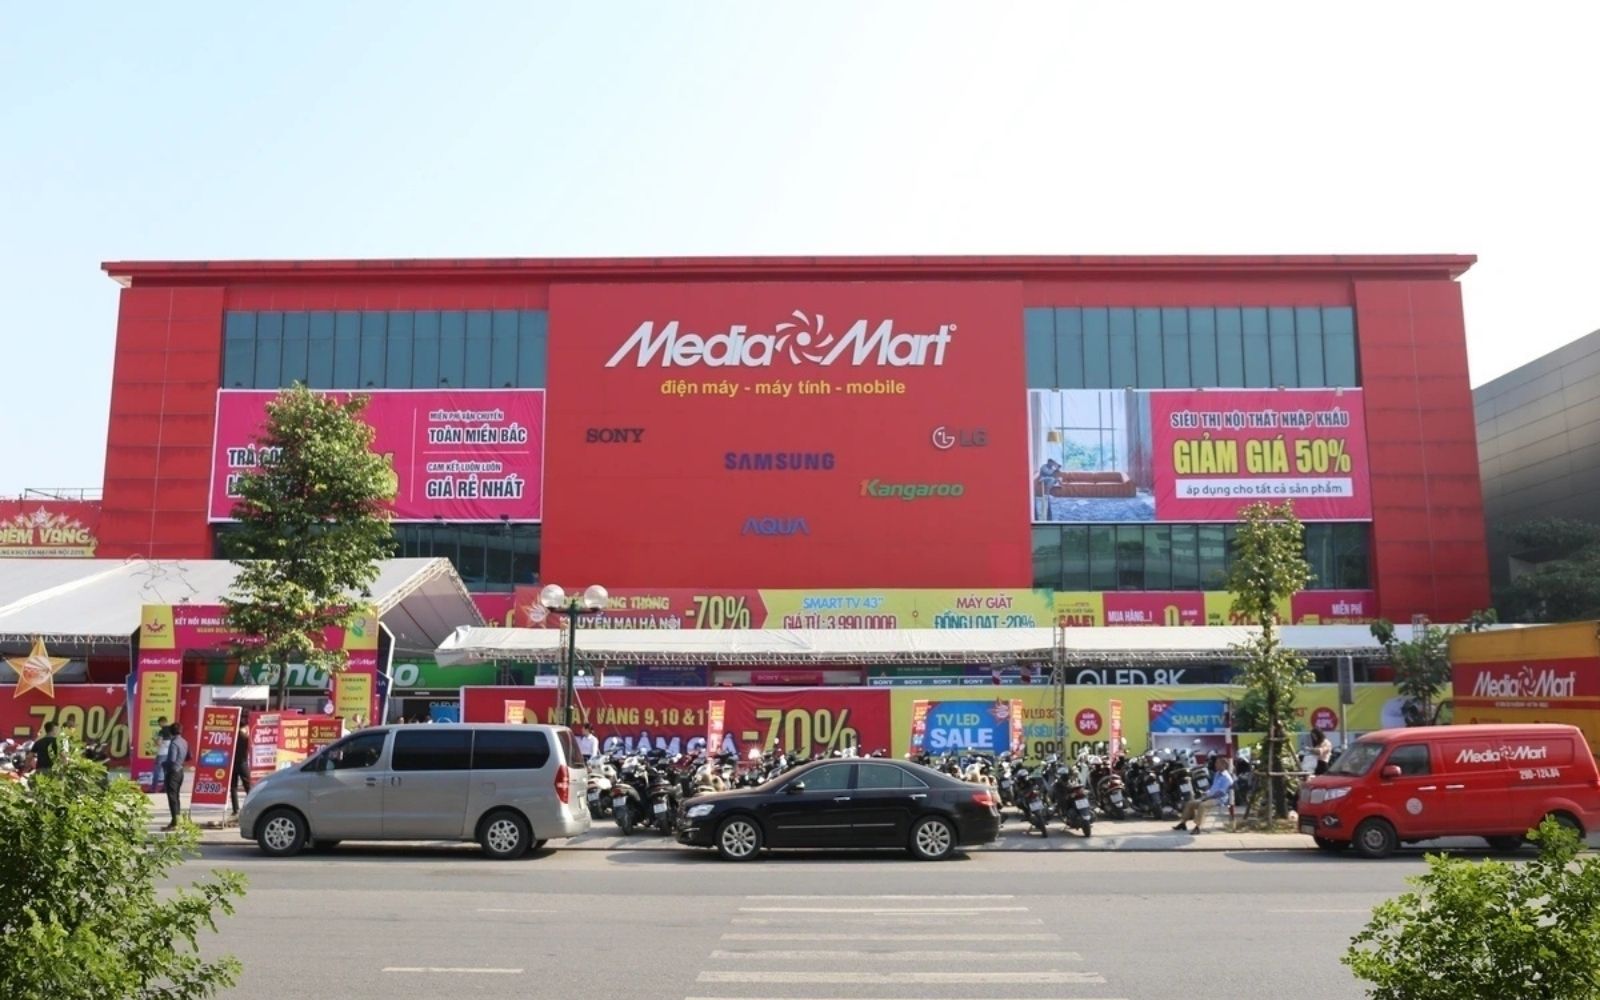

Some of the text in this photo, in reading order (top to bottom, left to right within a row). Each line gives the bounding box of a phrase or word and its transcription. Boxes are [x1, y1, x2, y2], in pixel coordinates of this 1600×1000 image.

[604, 320, 953, 367] Media Mart
[661, 380, 698, 397] điện
[702, 380, 739, 397] máy
[755, 380, 793, 397] máy
[798, 380, 831, 396] tính
[846, 380, 906, 395] mobile
[1171, 407, 1349, 430] SIÊU THỊ NỘI THẤT NHẬP KHẨU
[429, 424, 461, 443] TOÀN
[501, 422, 526, 443] BẮC
[586, 428, 645, 443] SONY
[959, 429, 989, 447] LG
[724, 452, 835, 470] SAMSUNG
[1173, 432, 1351, 474] GIẢM GIÁ 50%
[428, 462, 445, 472] CAM
[446, 459, 460, 472] KẾT
[427, 476, 454, 498] GIÁ
[458, 473, 477, 498] RẺ
[482, 473, 523, 498] NHẤT
[860, 479, 965, 500] Kangaroo
[1186, 479, 1342, 497] áp dụng cho tất cả sản phẩm
[741, 516, 809, 536] AQUA
[631, 594, 669, 611] THÁNG
[803, 597, 843, 609] SMART
[846, 597, 861, 609] TV
[956, 593, 981, 609] MÁY
[685, 596, 750, 629] -70%
[1472, 669, 1576, 697] Media Mart
[597, 704, 640, 725] VÀNG
[683, 709, 696, 725] &
[936, 713, 980, 726] TV LED
[1171, 715, 1209, 725] SMART
[742, 708, 857, 761] -70%
[930, 727, 993, 748] SALE
[1455, 745, 1547, 764] Media Mart
